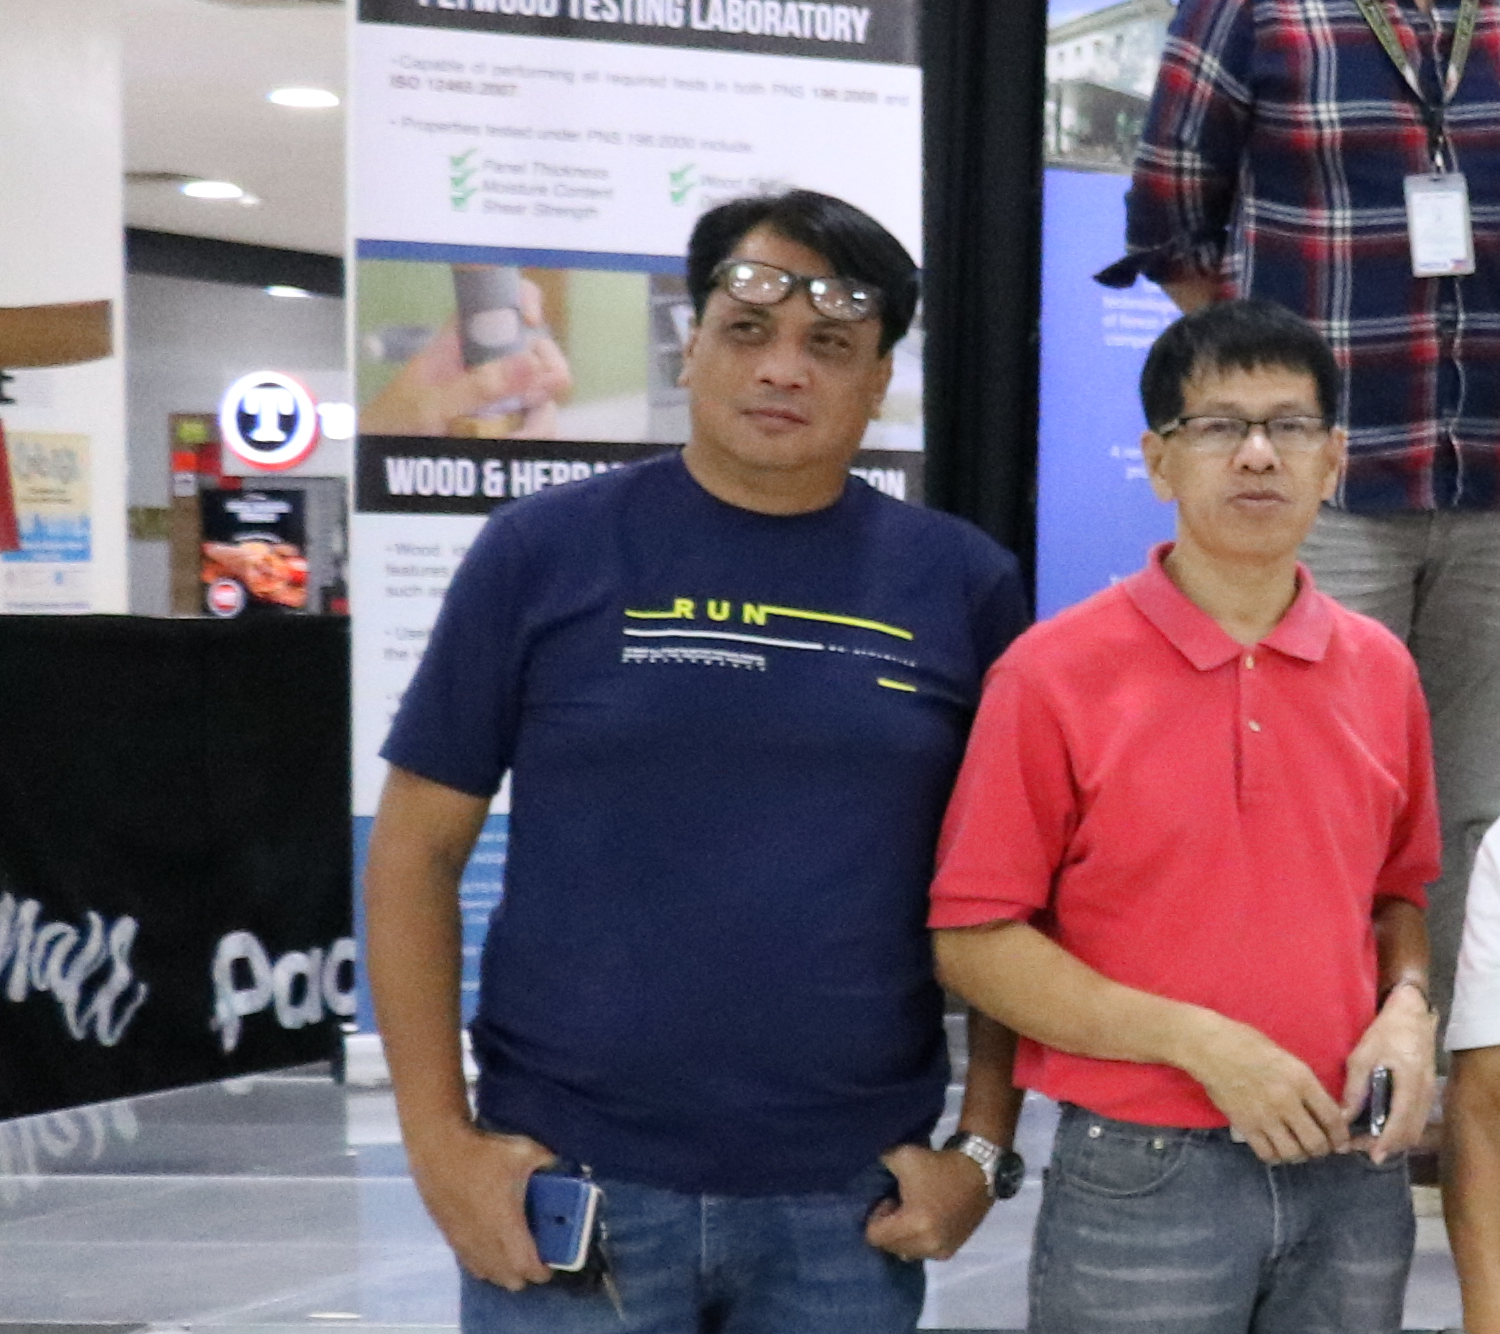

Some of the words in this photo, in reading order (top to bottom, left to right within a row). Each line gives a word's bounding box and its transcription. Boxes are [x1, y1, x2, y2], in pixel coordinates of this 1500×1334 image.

[385, 457, 477, 496] WOOD
[483, 460, 505, 498] &
[673, 597, 767, 626] RUN
